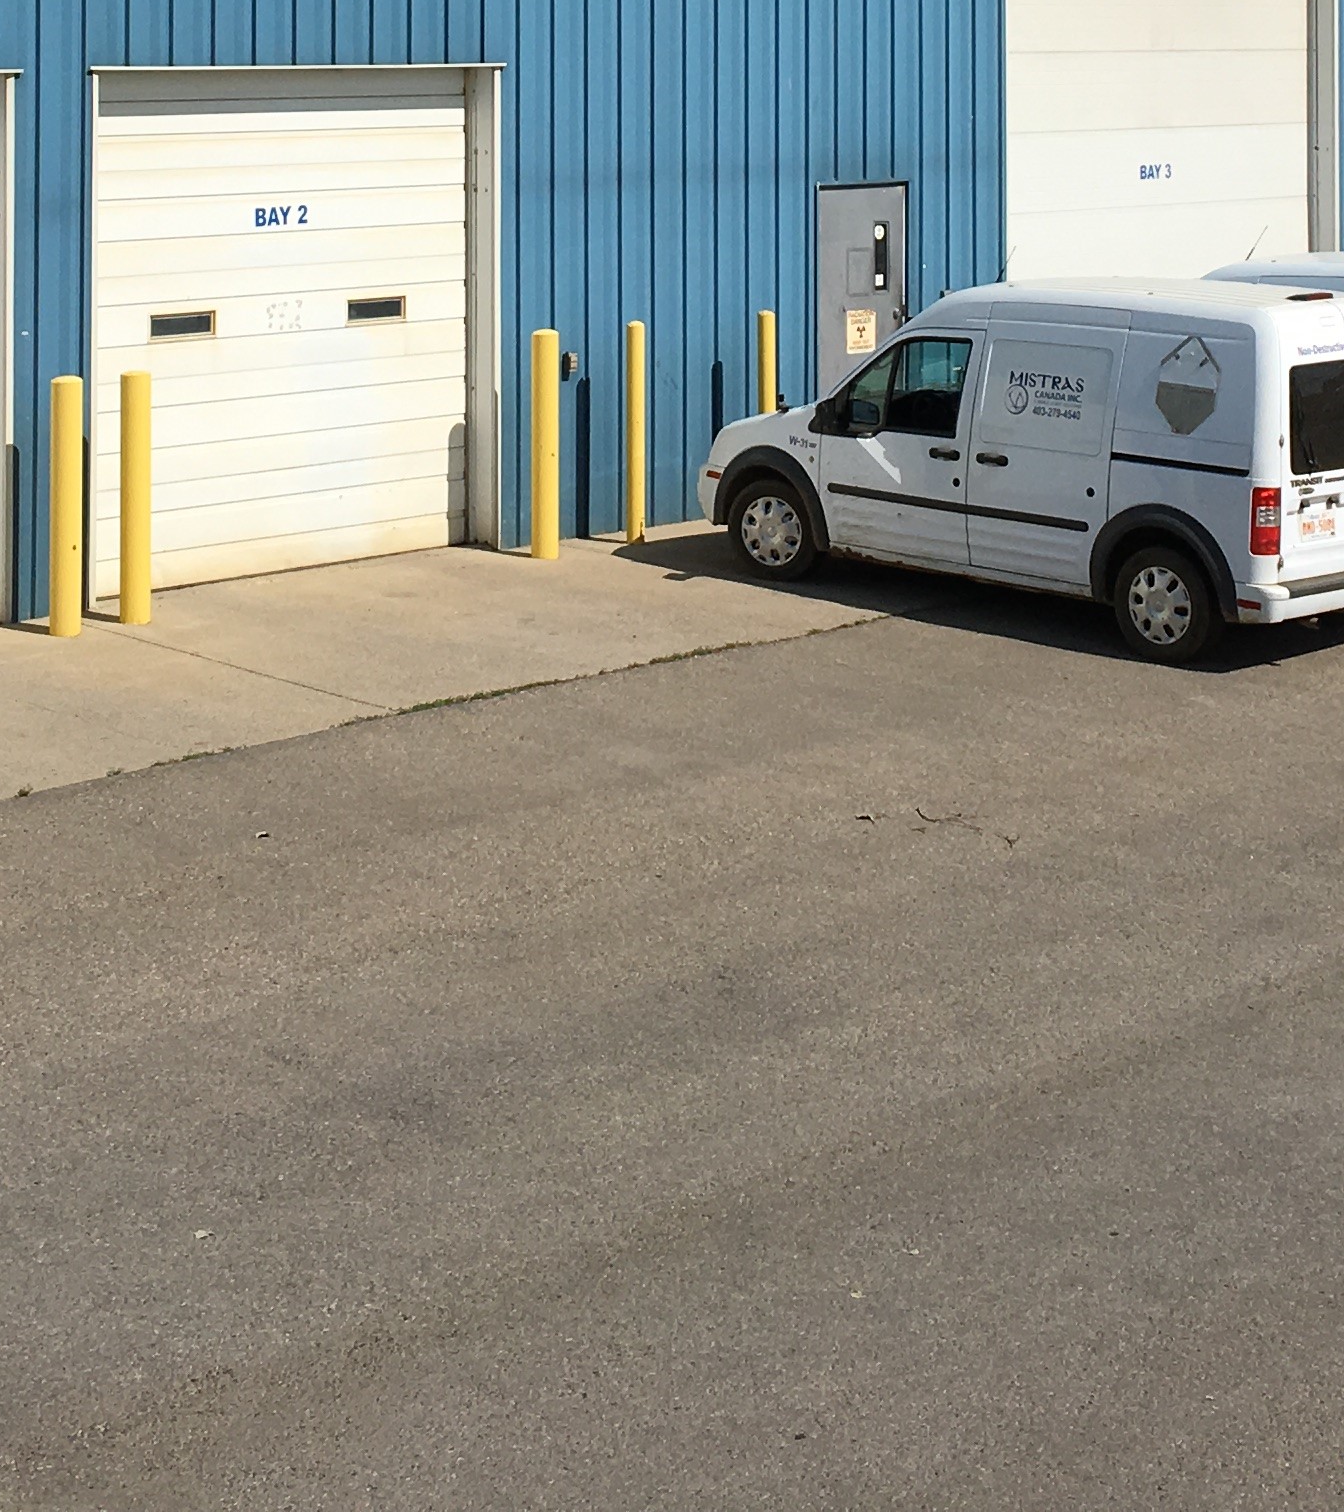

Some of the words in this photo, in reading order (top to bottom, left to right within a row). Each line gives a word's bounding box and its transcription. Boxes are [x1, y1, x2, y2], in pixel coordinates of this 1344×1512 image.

[1140, 164, 1162, 179] BAY
[1165, 163, 1172, 179] 3
[255, 206, 291, 227] BAY
[297, 204, 308, 224] 2
[1009, 370, 1084, 393] MISTRAS
[1035, 390, 1066, 401] CANADA
[1290, 476, 1323, 488] TRANSIT
